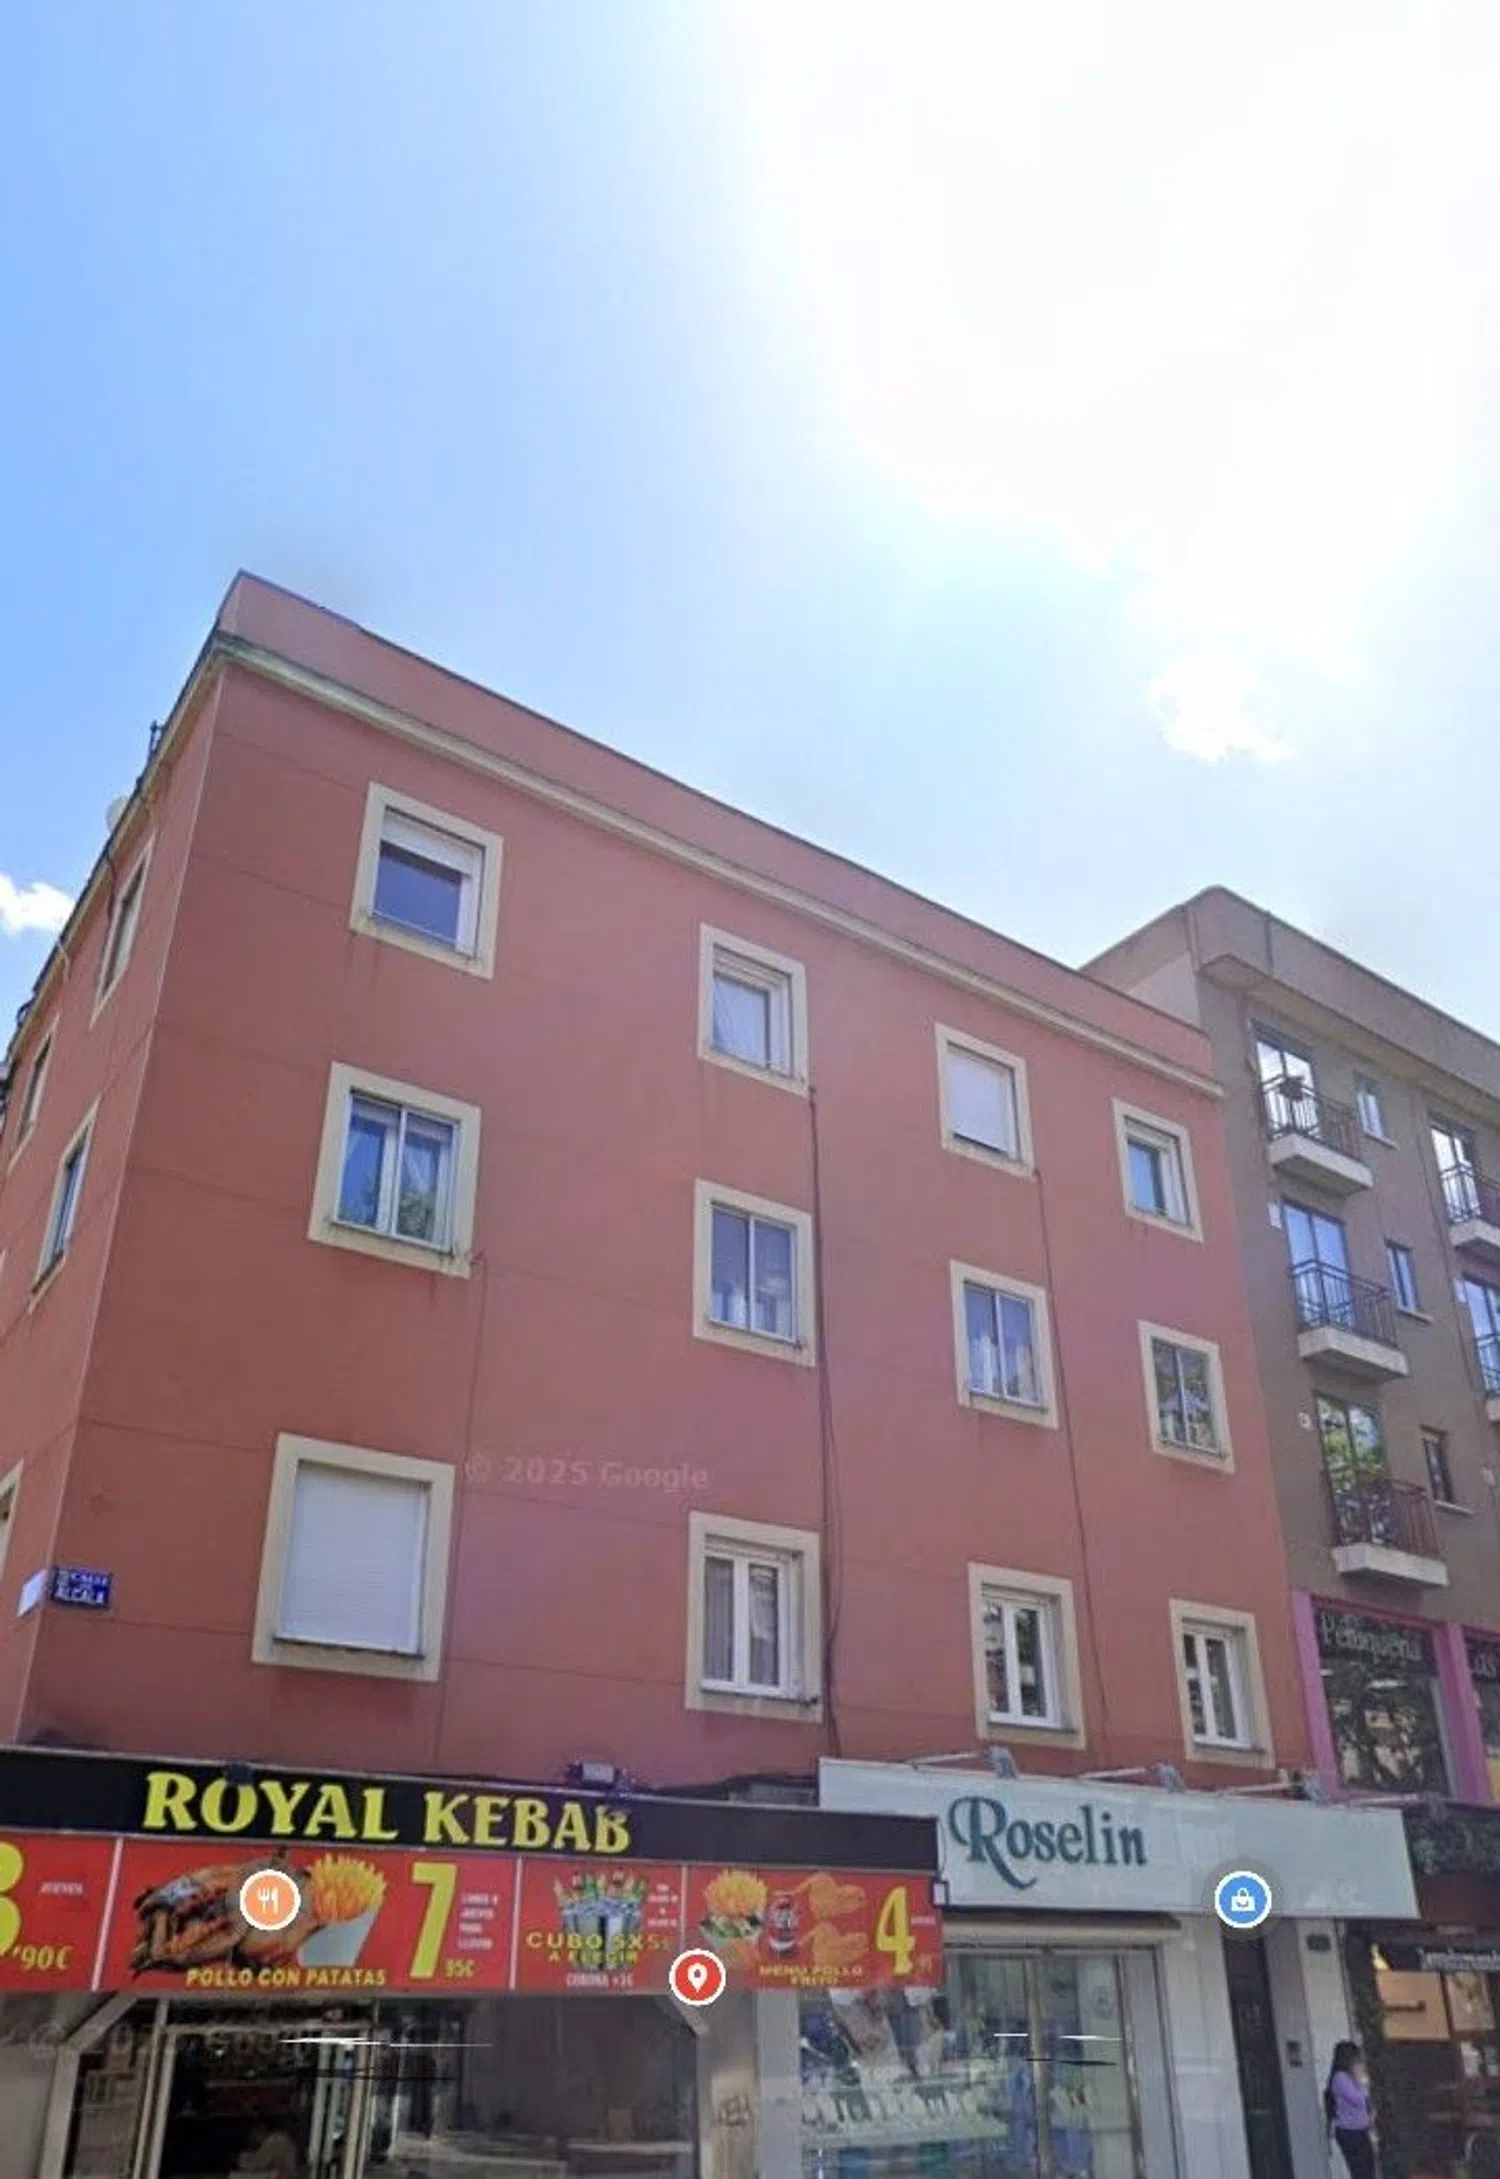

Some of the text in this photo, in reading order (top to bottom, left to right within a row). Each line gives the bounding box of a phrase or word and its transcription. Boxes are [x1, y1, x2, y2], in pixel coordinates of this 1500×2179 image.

[142, 1770, 632, 1854] ROYAL KEBAB
[948, 1795, 1147, 1890] Roselin
[410, 1862, 457, 1979] 7
[525, 1931, 603, 1950] CUBO
[876, 1886, 915, 1975] 4
[186, 1967, 386, 1987] POLLO CON PATATAS
